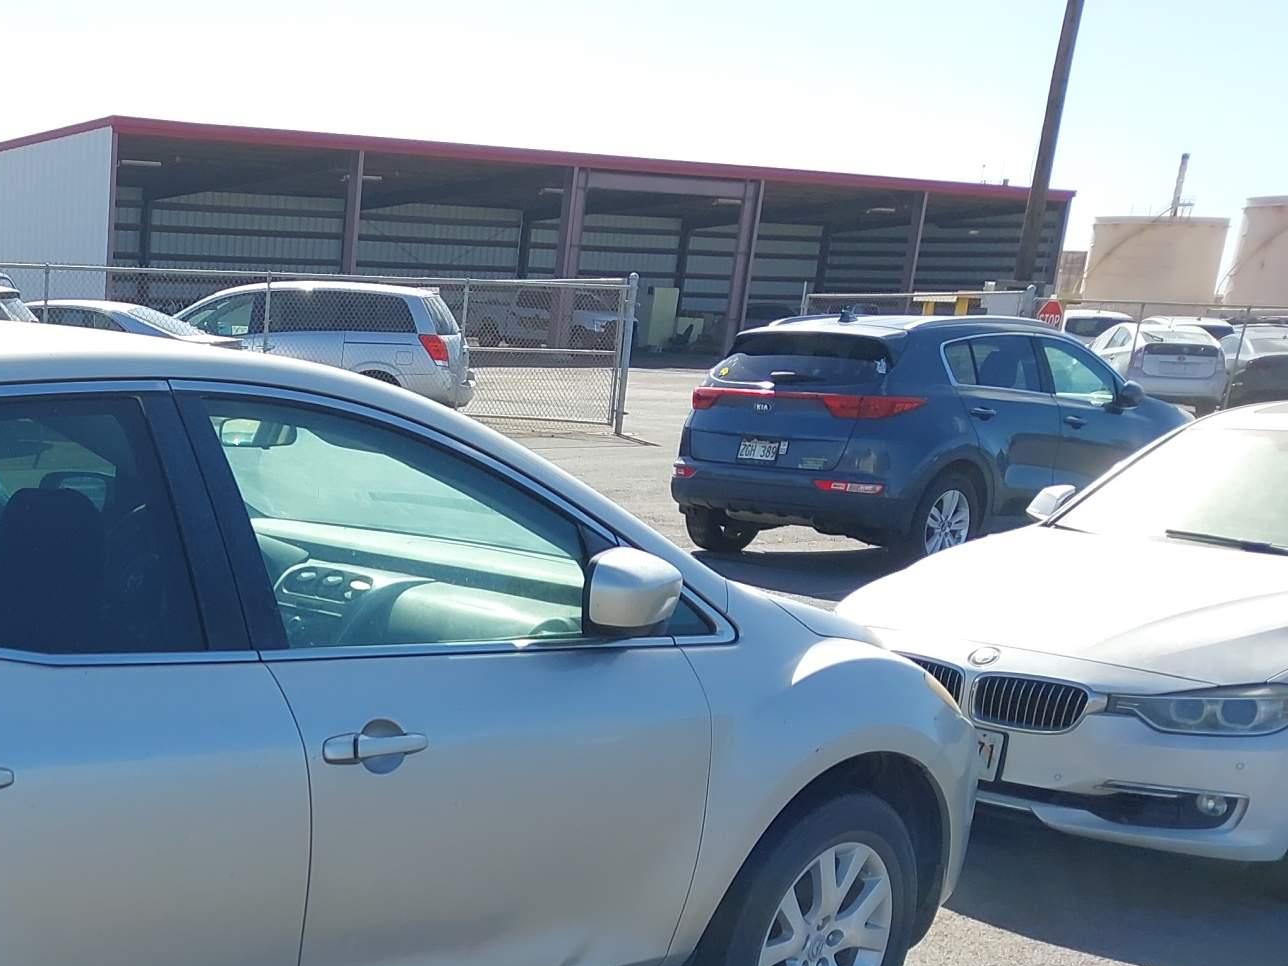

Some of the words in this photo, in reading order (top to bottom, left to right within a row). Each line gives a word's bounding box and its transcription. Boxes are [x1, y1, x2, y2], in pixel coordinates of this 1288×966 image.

[1039, 312, 1060, 328] STOP
[757, 403, 768, 411] KIA
[759, 445, 777, 458] 389
